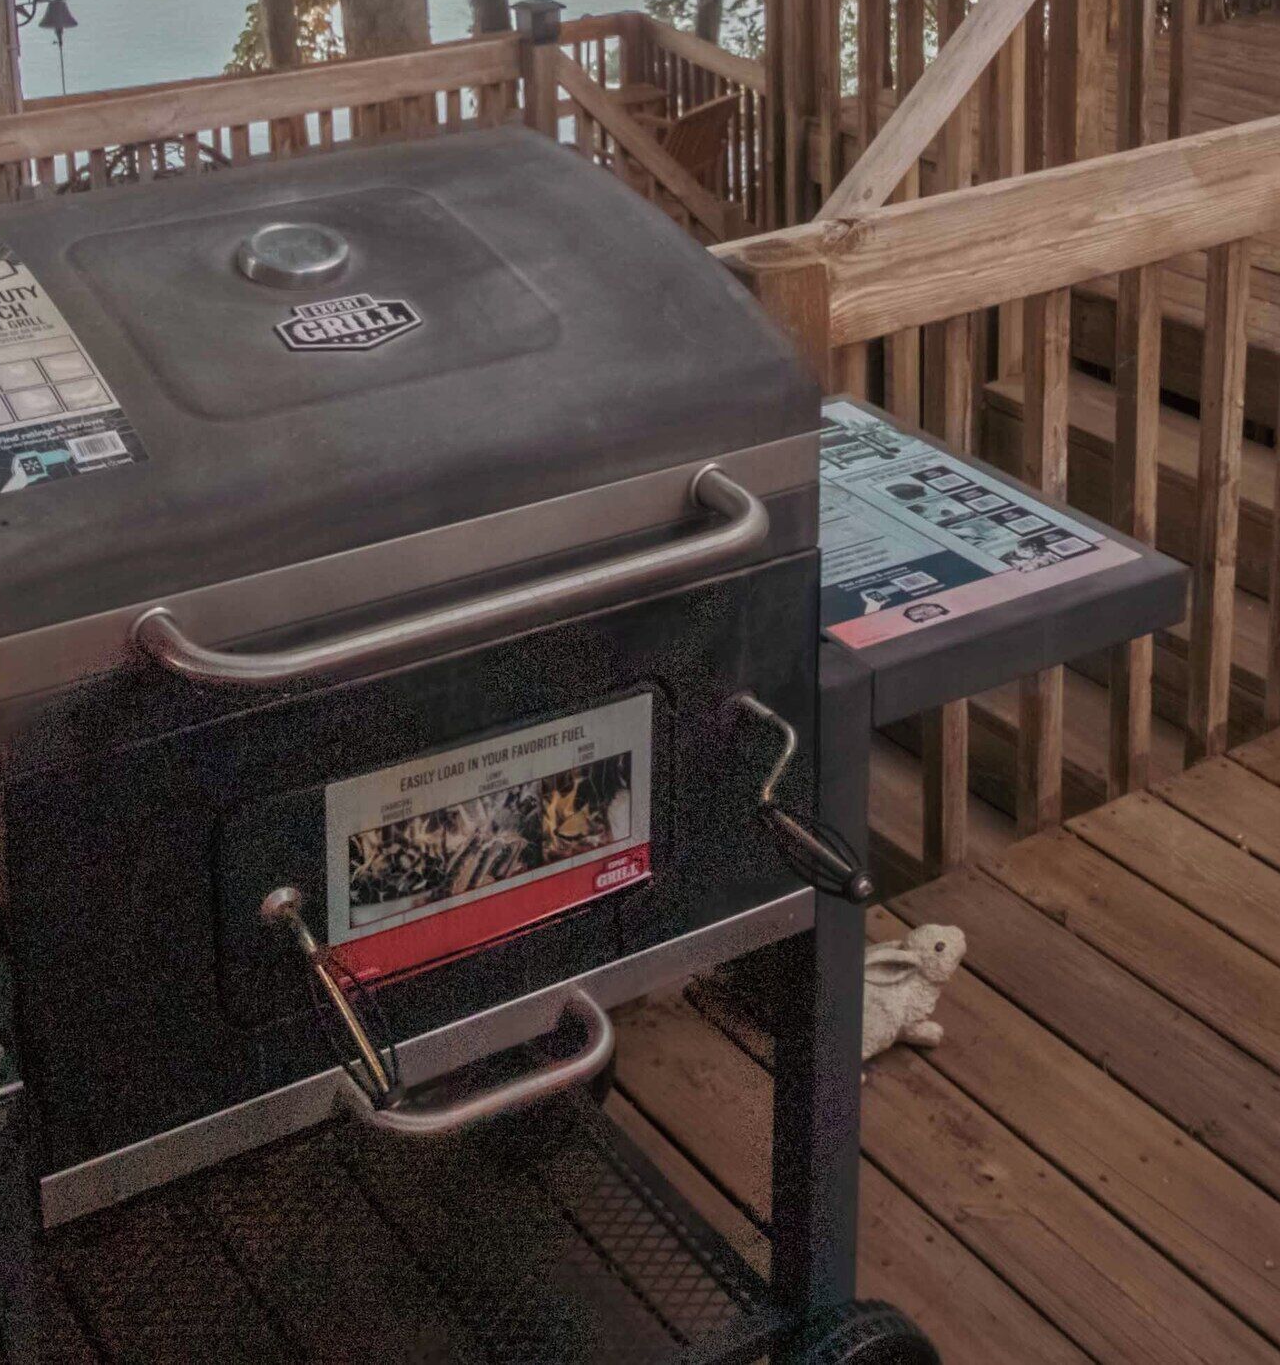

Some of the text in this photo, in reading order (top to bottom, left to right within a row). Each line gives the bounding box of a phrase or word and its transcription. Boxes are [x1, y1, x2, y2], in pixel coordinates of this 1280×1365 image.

[309, 298, 361, 316] EXPERT
[8, 315, 47, 330] GRILL
[292, 306, 407, 342] GRILL
[400, 726, 587, 792] EASILY LOAD IN YOUR FAVORITE FUEL
[596, 863, 640, 888] GRILL
